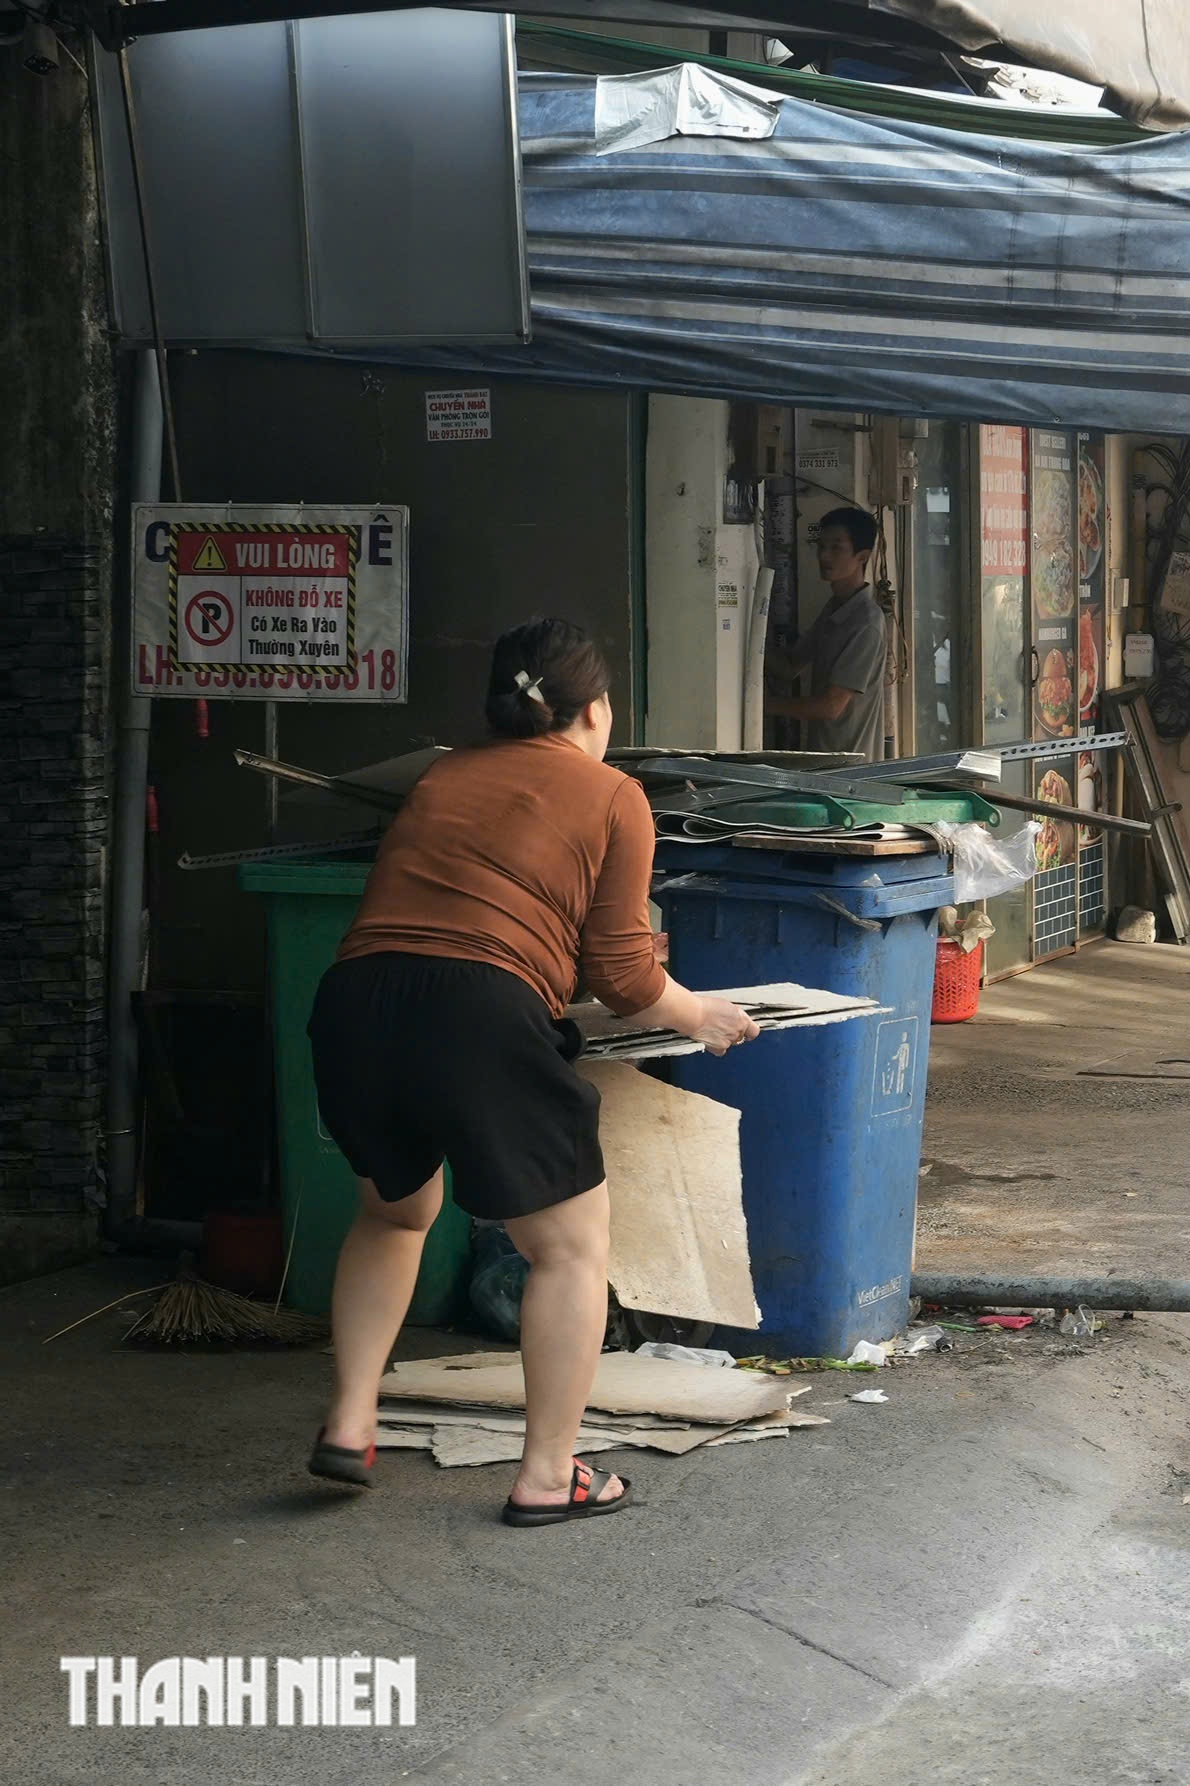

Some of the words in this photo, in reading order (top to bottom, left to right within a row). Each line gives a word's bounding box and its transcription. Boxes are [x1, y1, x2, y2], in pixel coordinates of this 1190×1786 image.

[430, 399, 465, 412] CHUYỂN
[235, 543, 270, 568] VUI
[277, 537, 335, 569] LÒNG
[245, 586, 294, 608] KHÔNG
[298, 584, 319, 608] ĐỖ
[323, 590, 343, 608] XE
[251, 616, 267, 633] Có
[271, 617, 287, 633] Xe
[291, 617, 308, 633] Ra
[312, 617, 337, 633] Vào
[248, 639, 294, 657] Thường
[299, 639, 339, 657] Xuyên
